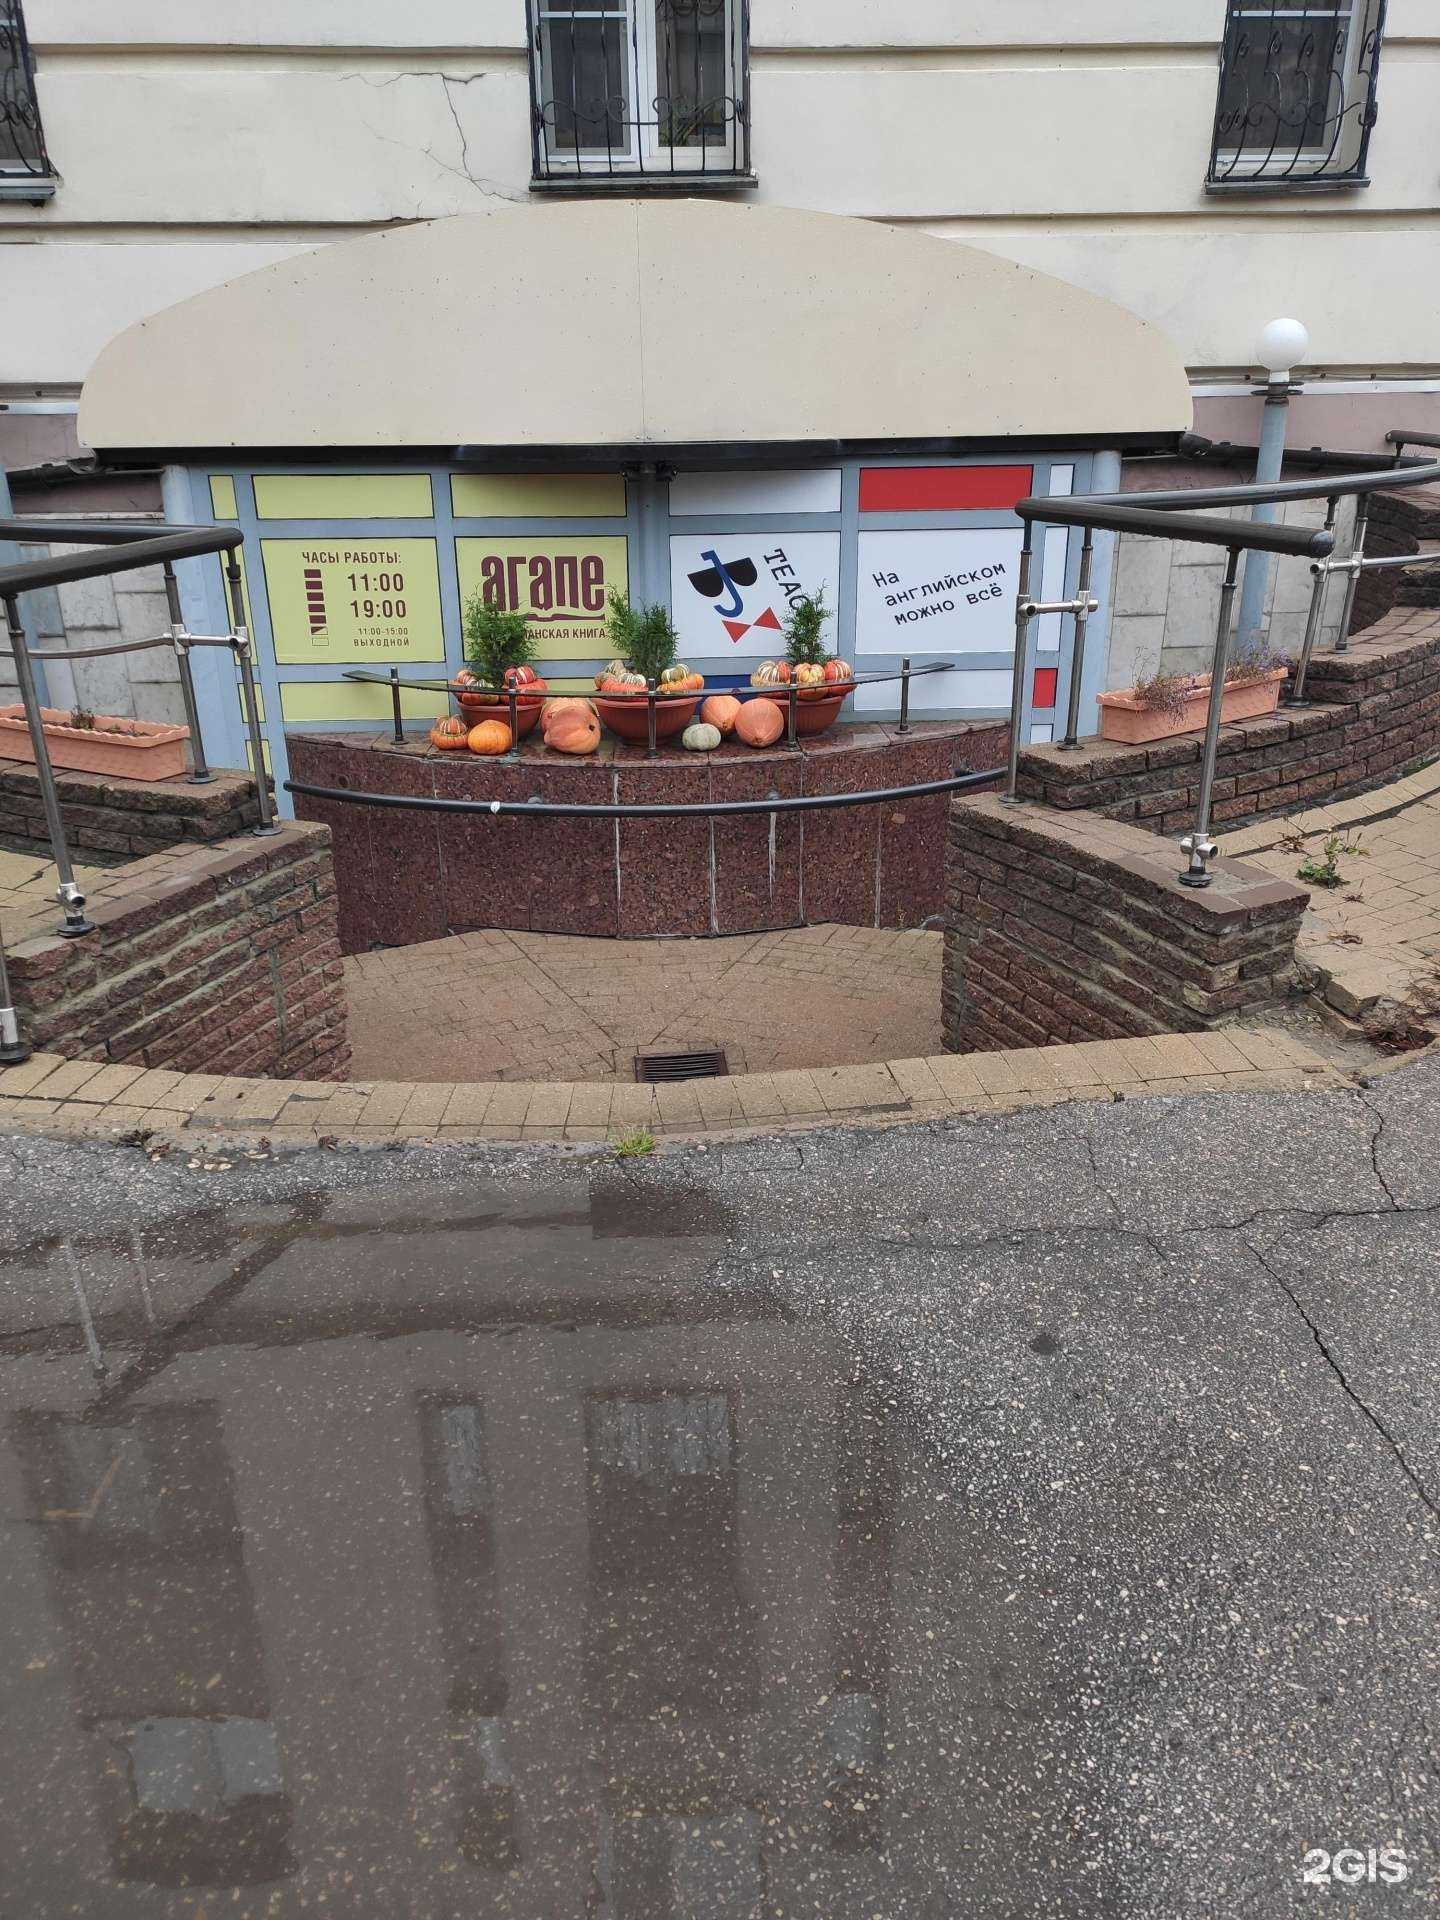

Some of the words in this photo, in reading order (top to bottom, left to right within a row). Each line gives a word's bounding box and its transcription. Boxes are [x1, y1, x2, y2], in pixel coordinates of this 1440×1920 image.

[302, 551, 340, 564] ЧАСЫ
[344, 551, 402, 564] РАБОТЫ:
[347, 573, 404, 592] 11:00
[481, 555, 605, 612] агапе
[763, 547, 812, 611] TEAC
[872, 571, 900, 588] На
[884, 563, 1006, 606] английском
[350, 600, 407, 618] 19:00
[894, 600, 955, 625] можно
[966, 582, 1003, 605] всё
[358, 627, 409, 636] 11:00-15:00
[572, 627, 606, 639] КНИГА
[353, 637, 410, 648] ВЫХОДНОЙ
